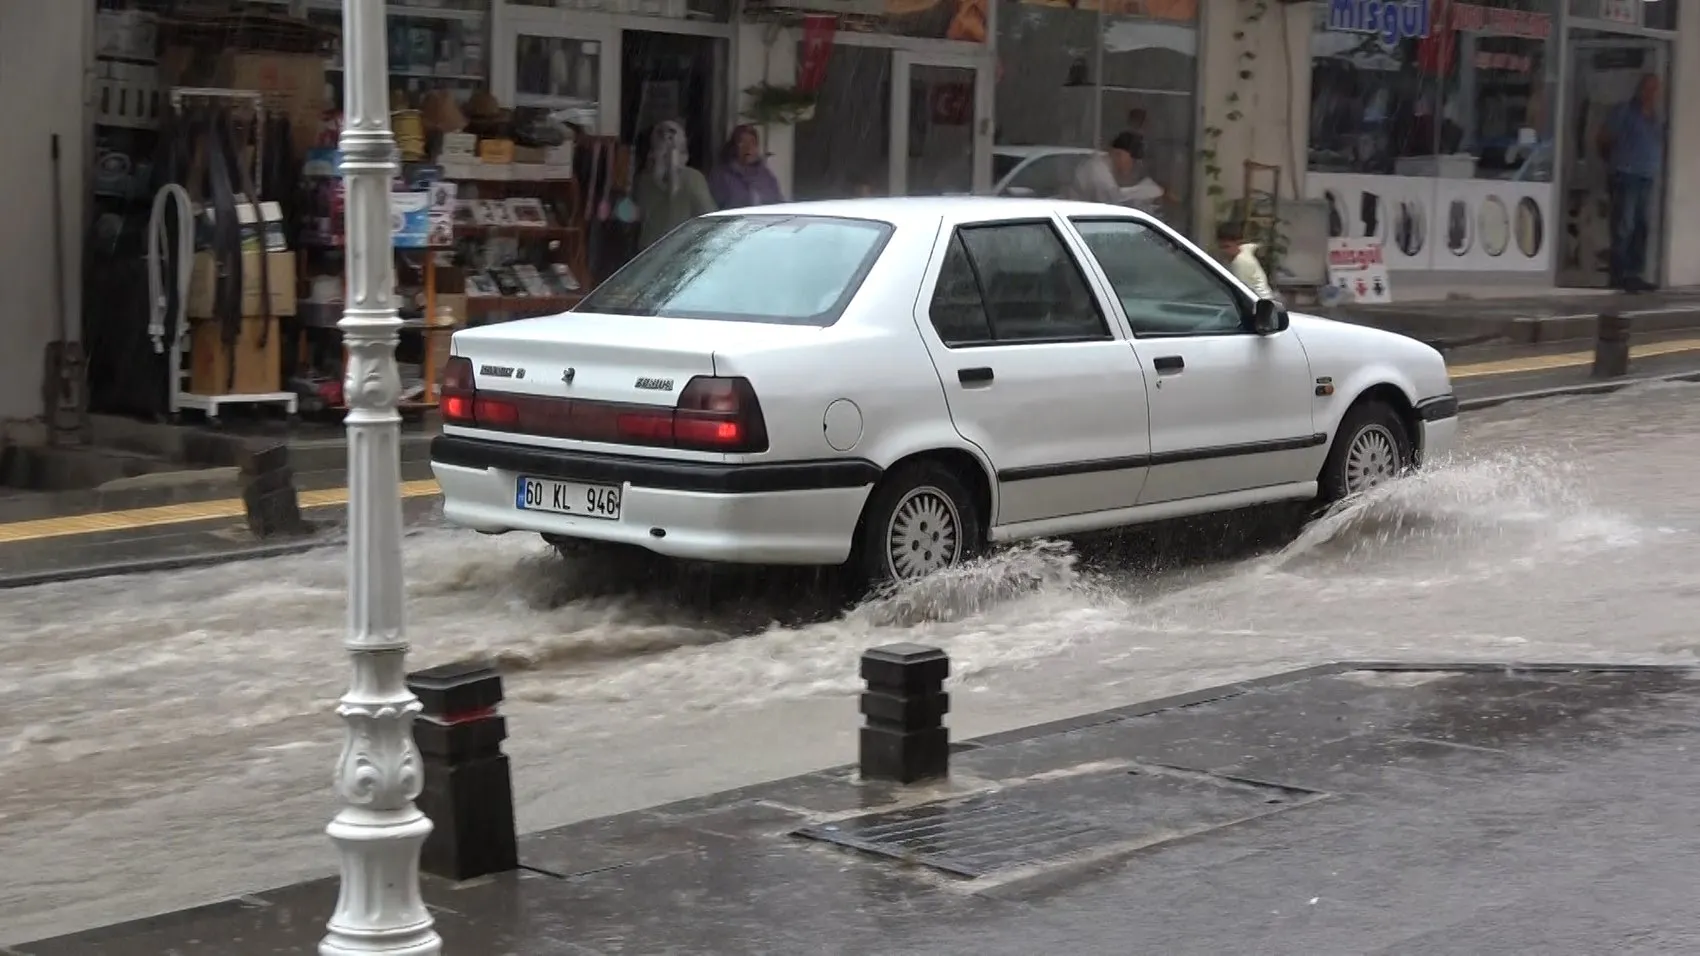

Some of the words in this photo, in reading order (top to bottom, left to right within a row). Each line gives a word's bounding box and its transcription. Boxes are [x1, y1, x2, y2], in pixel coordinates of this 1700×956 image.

[526, 481, 543, 506] 60
[553, 483, 571, 510] KL
[586, 488, 618, 515] 946
